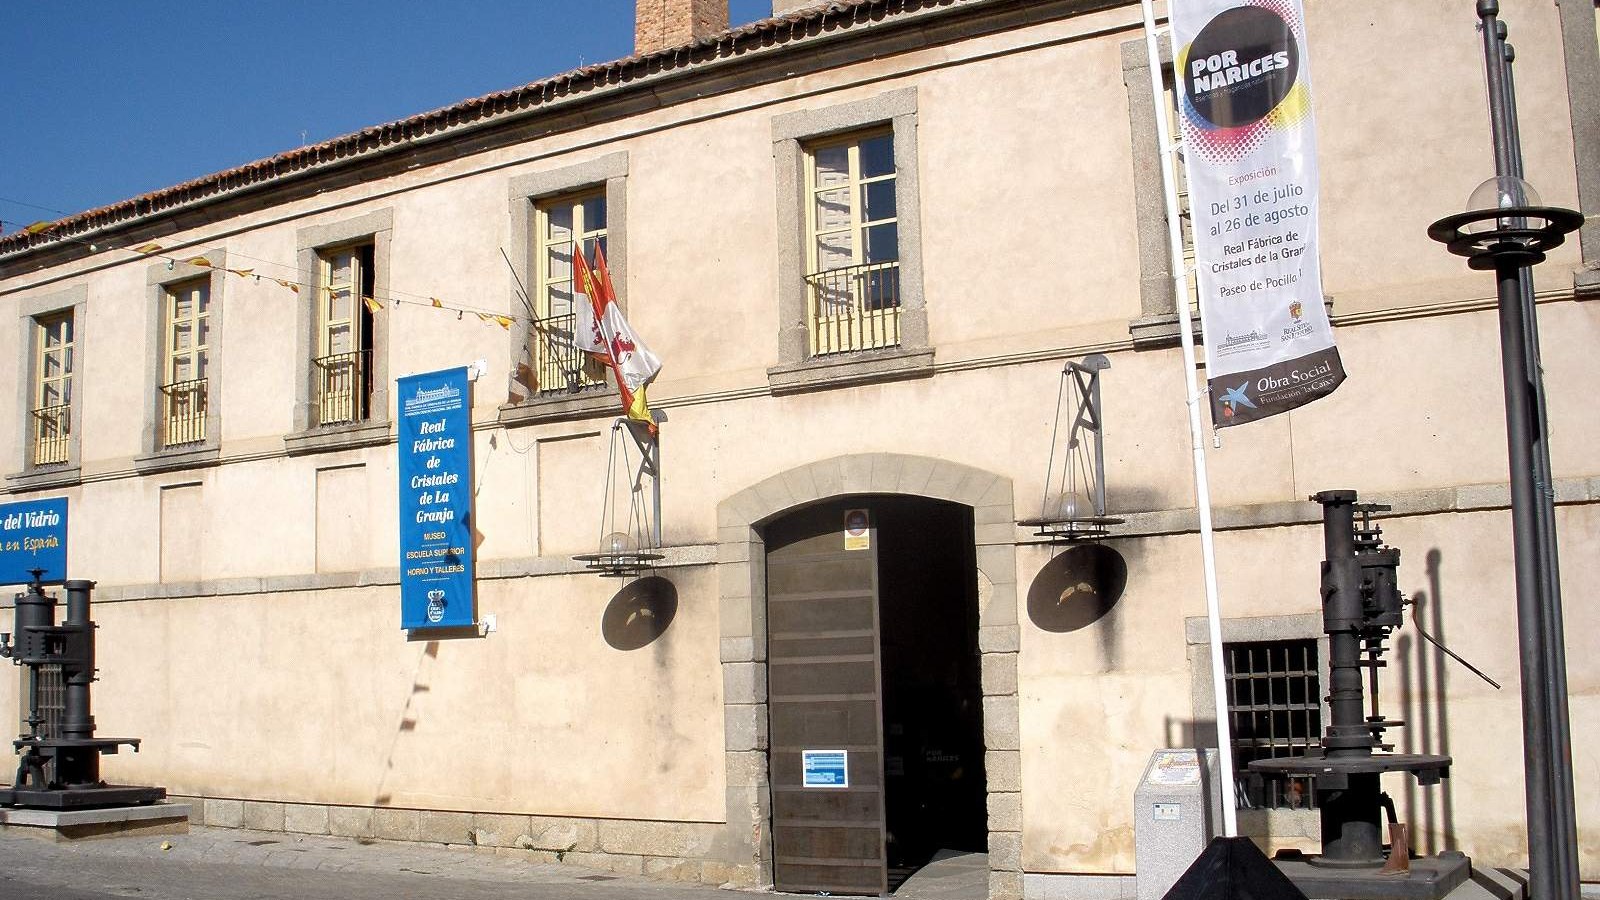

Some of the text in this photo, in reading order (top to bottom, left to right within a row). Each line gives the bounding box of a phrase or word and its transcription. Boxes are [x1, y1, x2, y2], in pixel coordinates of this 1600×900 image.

[1191, 49, 1239, 77] POR
[1193, 51, 1289, 94] NARICES
[1228, 166, 1277, 186] Exposición
[1211, 184, 1303, 216] Del 31 de julio
[1210, 204, 1308, 236] al 26 de agosto
[1224, 231, 1298, 256] Real Fábrica de
[1212, 258, 1252, 274] Cristales
[1254, 254, 1267, 264] de
[1270, 251, 1278, 261] la
[1220, 284, 1246, 298] Paseo
[1257, 360, 1331, 392] Obra Social
[1260, 390, 1301, 404] Fundación
[420, 418, 446, 435] Real
[412, 436, 454, 454] Fábrica
[426, 456, 440, 469] de
[411, 472, 458, 489] Cristales
[420, 489, 450, 504] de La
[4, 512, 23, 530] del
[25, 510, 60, 528] Vidrio
[416, 507, 454, 524] Granja
[6, 541, 20, 551] en
[24, 534, 59, 556] España
[424, 532, 446, 540] MUSEO
[406, 547, 464, 558] ESCUELA SUPERIOR
[408, 567, 428, 576] HORNO
[435, 564, 464, 574] TALLERES
